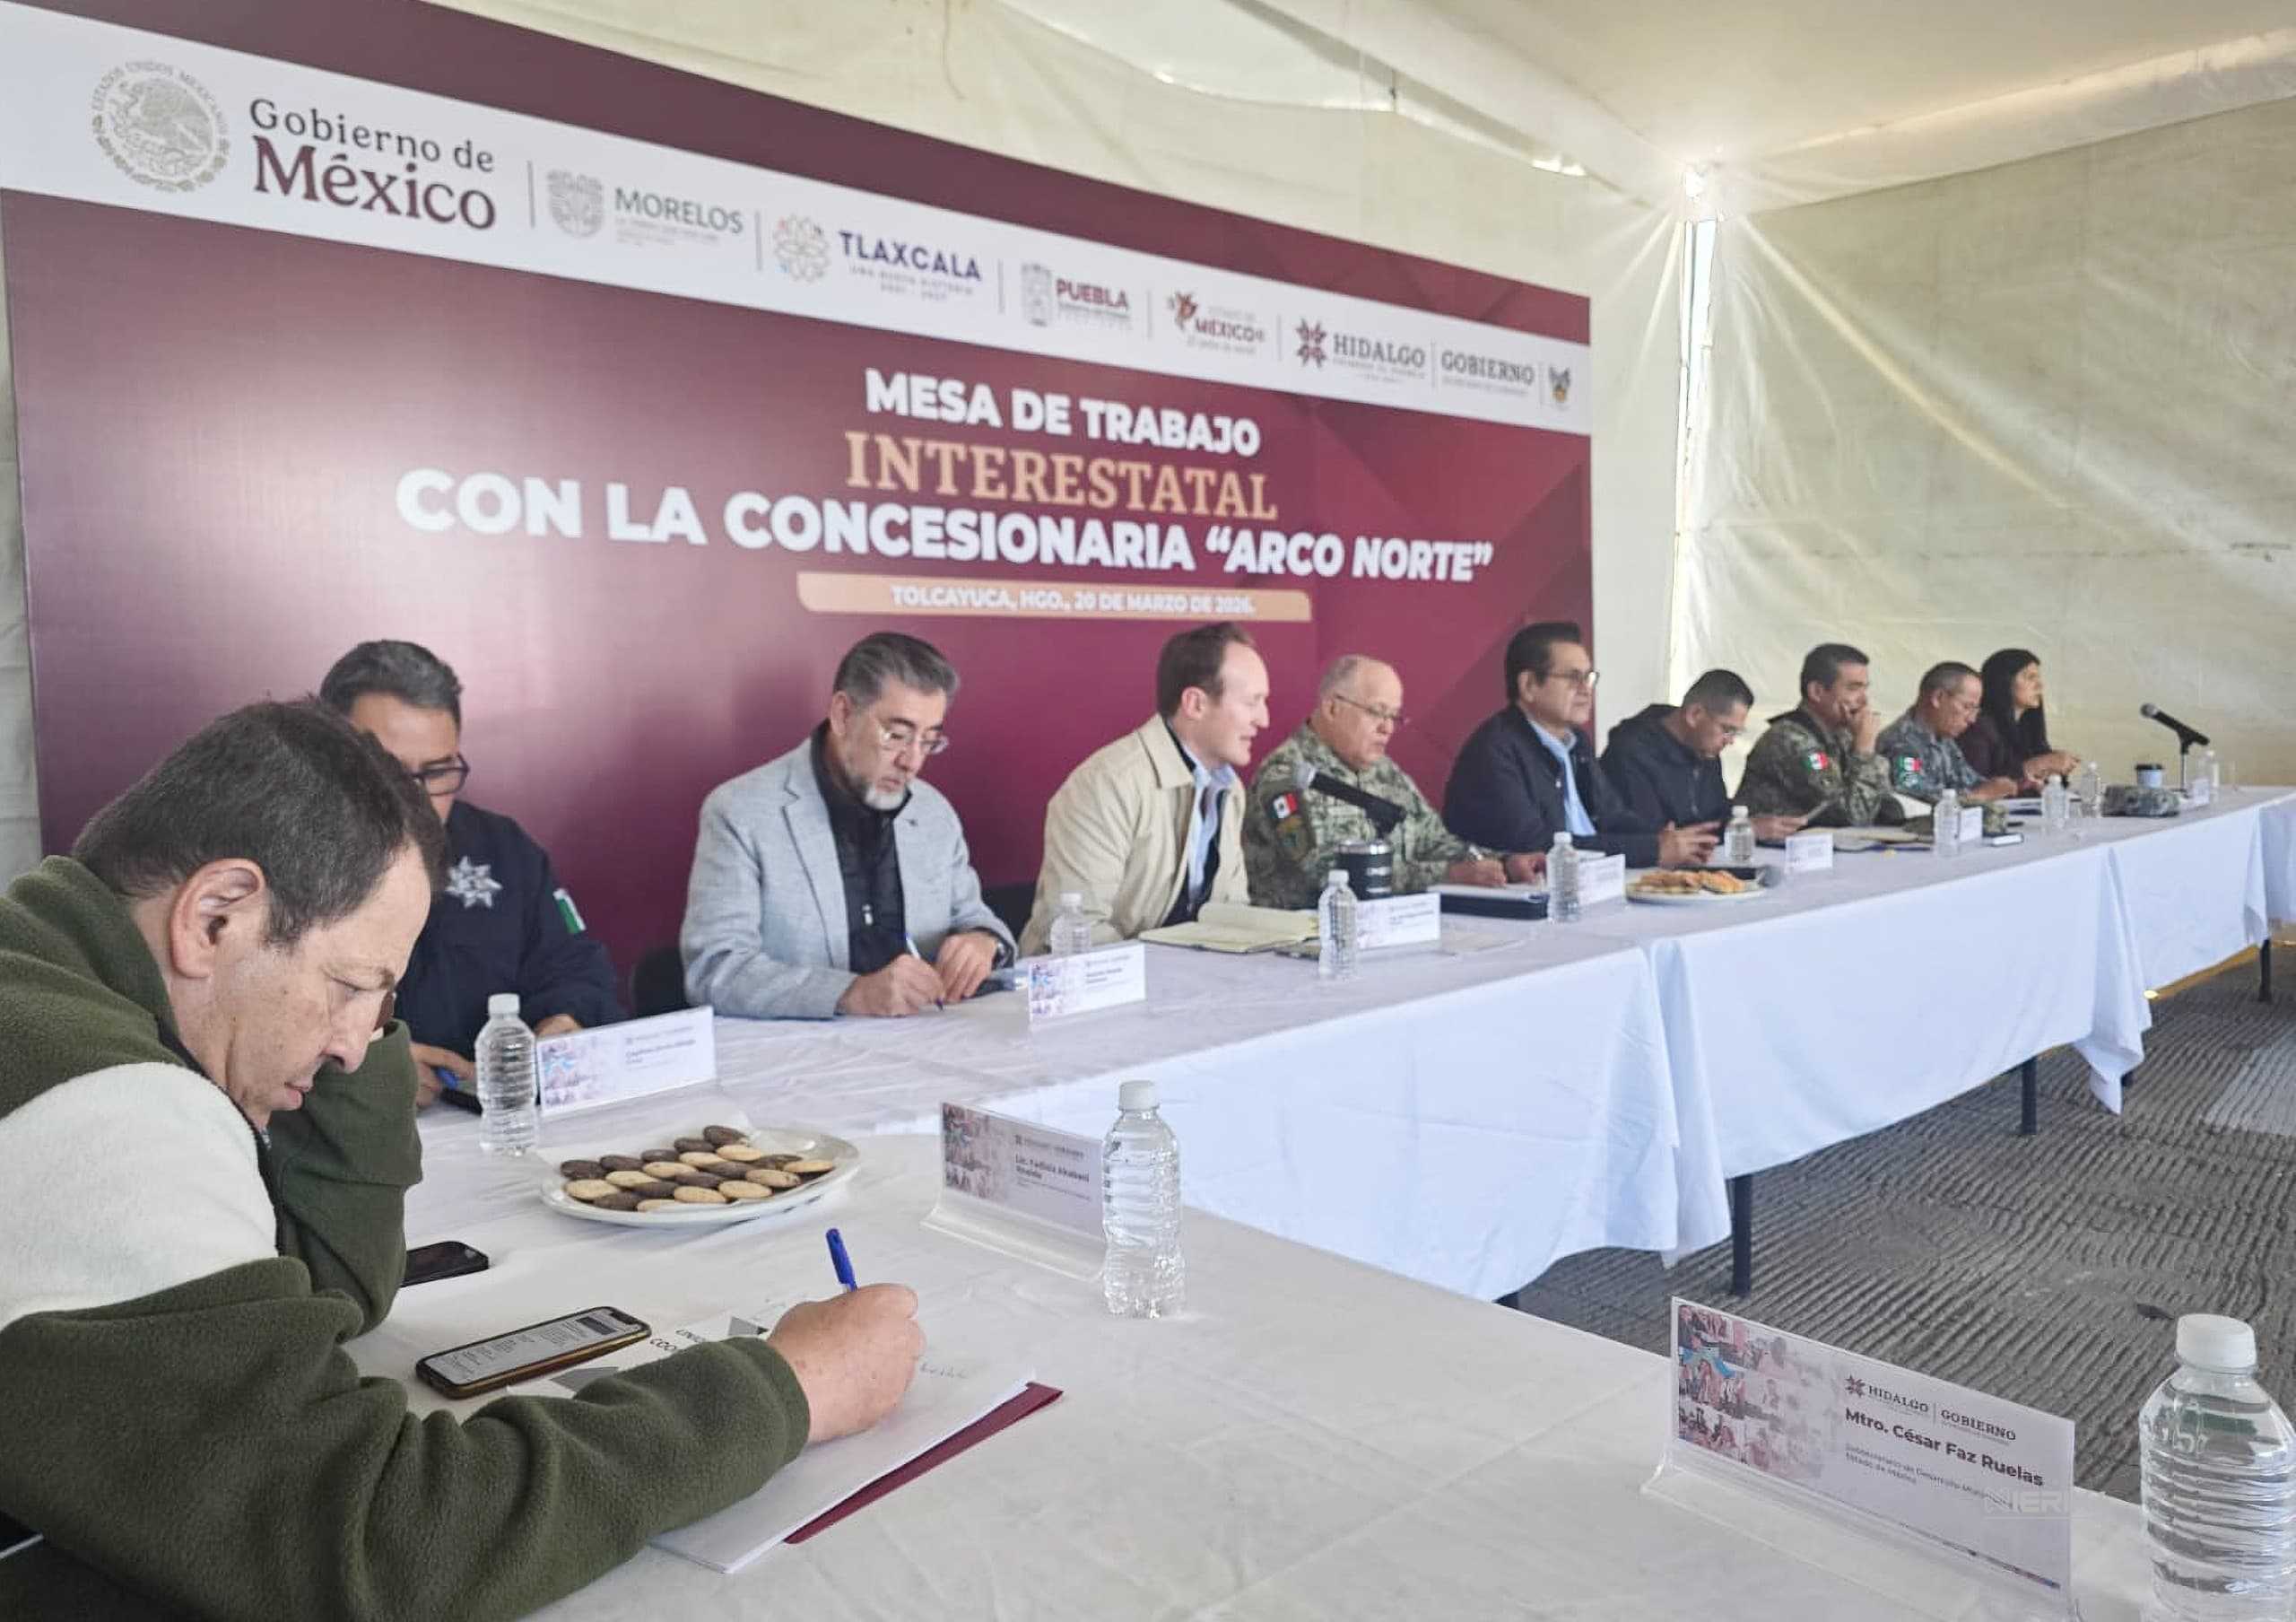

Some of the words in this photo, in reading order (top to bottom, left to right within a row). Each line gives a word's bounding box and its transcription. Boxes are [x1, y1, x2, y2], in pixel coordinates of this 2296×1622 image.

[250, 98, 440, 162] Gobierno
[454, 139, 494, 173] de
[252, 135, 496, 230] México
[615, 187, 744, 234] MORELOS
[839, 231, 982, 282] TLAXCALA
[1056, 278, 1130, 310] PUEBLA
[1333, 332, 1427, 369] HIDALGO
[1440, 349, 1535, 387] GOBIERNO
[865, 368, 1003, 429] MESA
[1012, 388, 1073, 437] DE
[1081, 397, 1262, 458] TRABAJO
[845, 430, 1279, 521] INTERESTATAL
[395, 467, 583, 539] CON
[605, 482, 710, 546] LA
[723, 492, 1196, 572] CONCESIONARIA
[1205, 525, 1345, 579] “ARCO
[1352, 536, 1494, 583] NORTE”
[891, 584, 1019, 611] TOLCAYUCA,
[1074, 590, 1096, 610] 20
[1099, 591, 1123, 612] DE
[1126, 592, 1188, 614] MARZO
[1190, 594, 1213, 615] DE
[1868, 1384, 1929, 1413] HIDALGO
[1844, 1407, 1890, 1435] Mtro.
[1892, 1424, 1942, 1452] César
[1945, 1442, 1977, 1464] Faz
[1981, 1453, 2045, 1487] Ruelas
[1940, 1408, 2017, 1441] GOBIERNO
